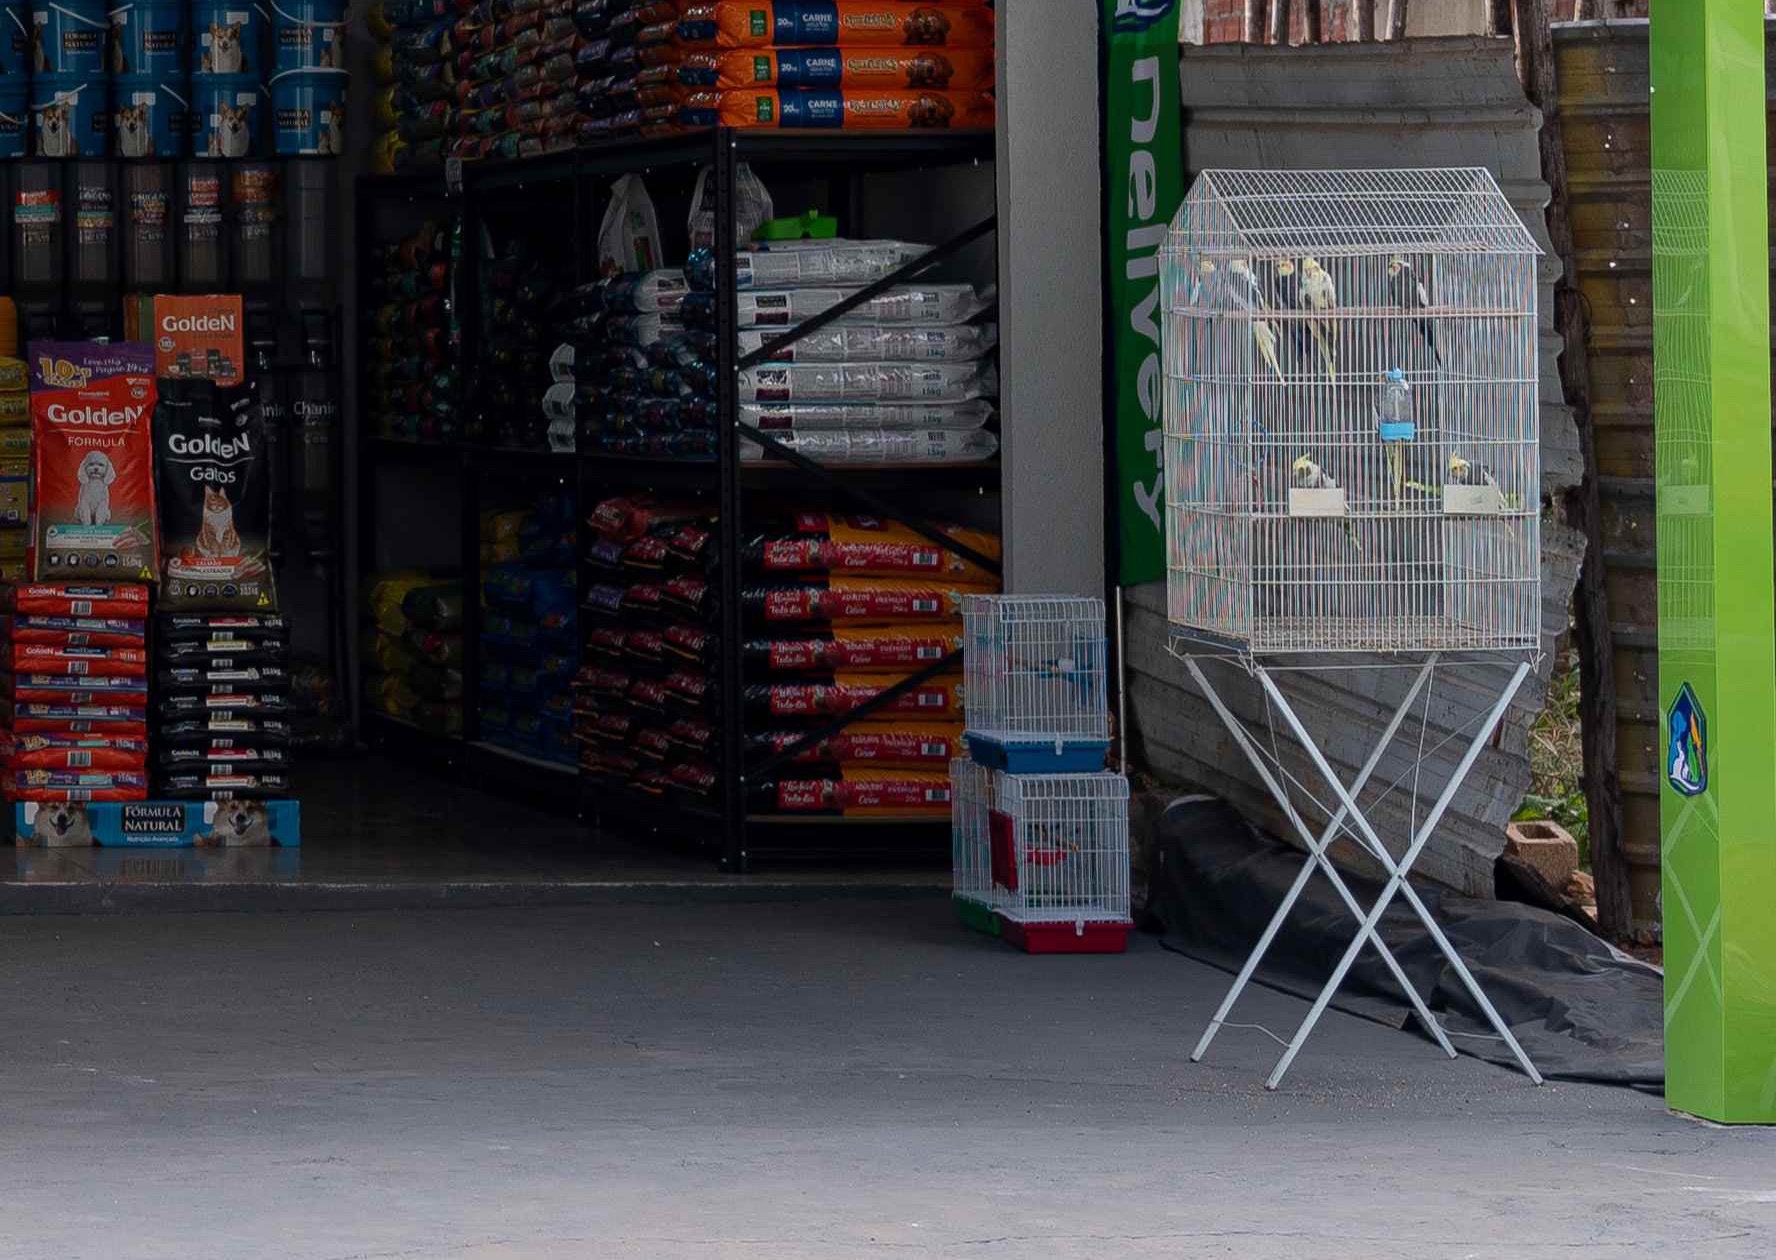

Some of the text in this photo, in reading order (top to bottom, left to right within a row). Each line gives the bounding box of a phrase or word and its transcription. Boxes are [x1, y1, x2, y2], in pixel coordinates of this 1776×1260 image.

[162, 314, 235, 332] GoldeN
[47, 403, 143, 426] GoldeN
[168, 432, 250, 459] GoldeN
[190, 466, 237, 484] Gatos
[125, 819, 182, 832] NATURAL
